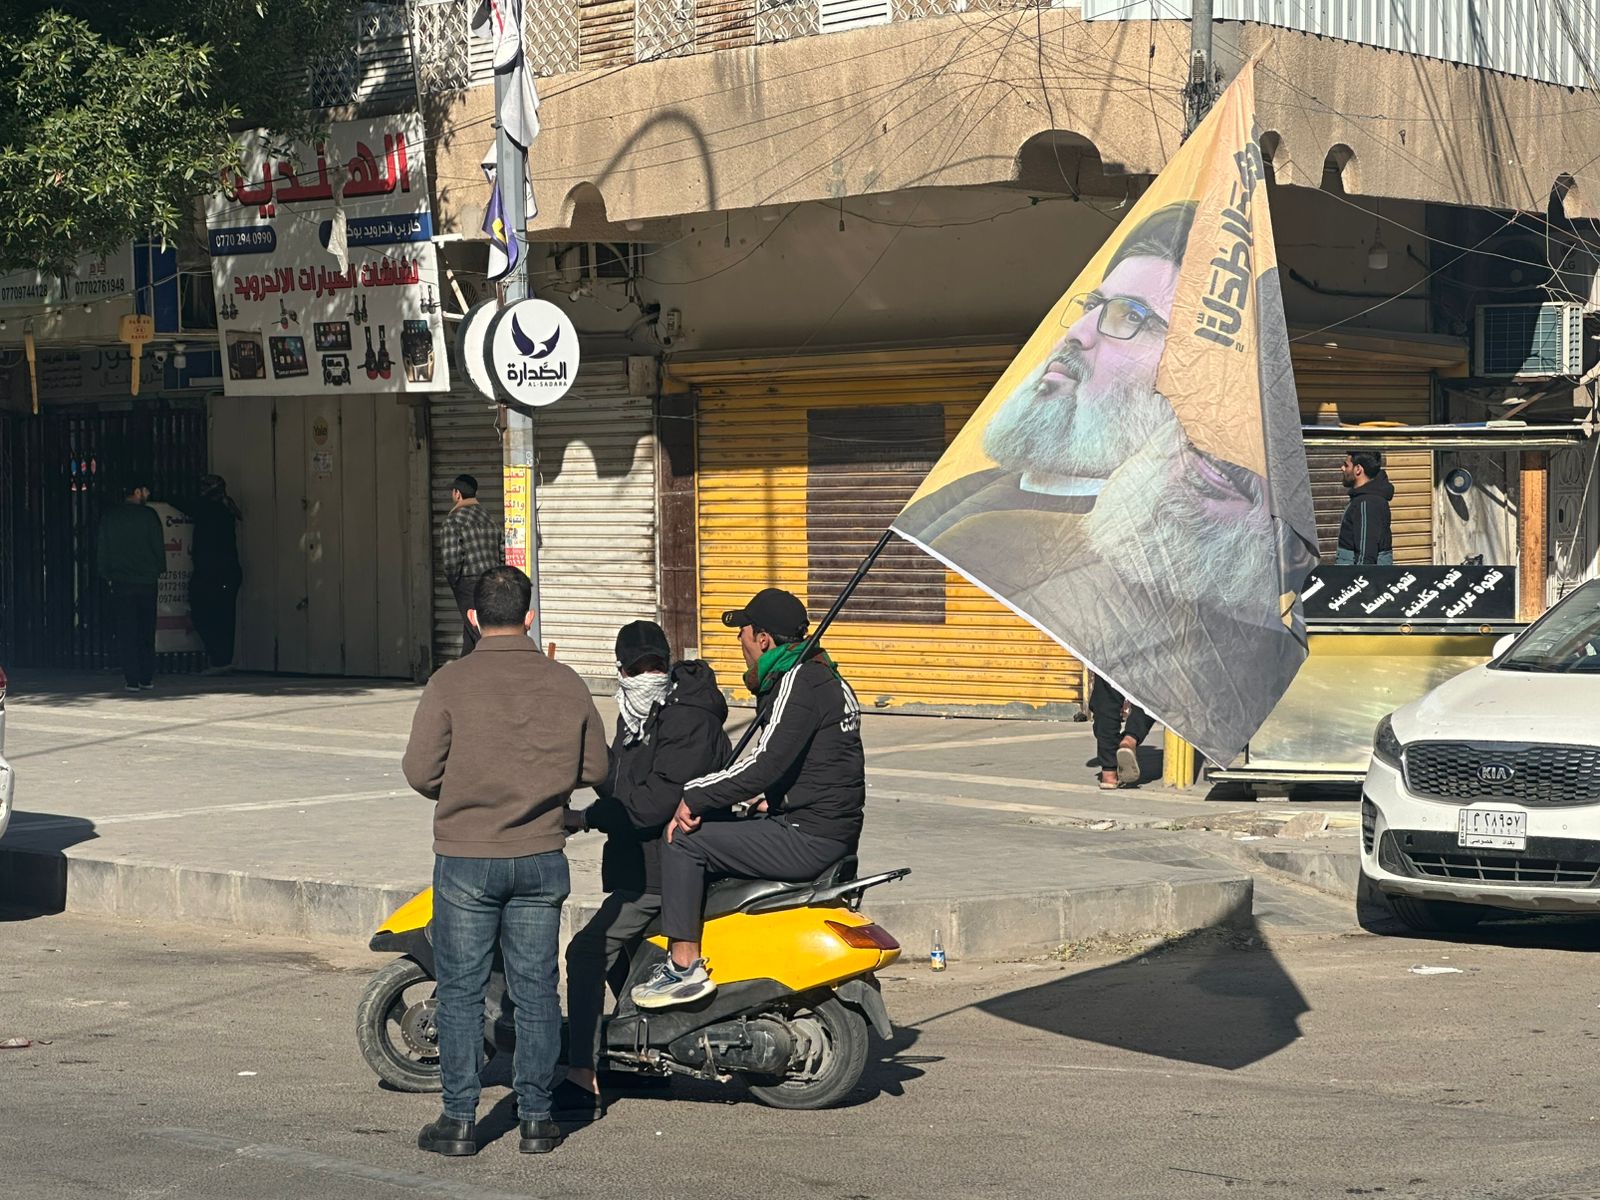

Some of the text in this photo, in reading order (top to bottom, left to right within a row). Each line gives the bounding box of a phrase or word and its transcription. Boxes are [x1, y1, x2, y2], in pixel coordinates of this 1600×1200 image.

[215, 231, 272, 247] 0770 294 0990
[75, 278, 125, 295] 07702761948
[1433, 568, 1462, 590] قهوة
[1328, 575, 1369, 611] كابتشينو
[1361, 571, 1416, 614] قهوة وسط
[1440, 568, 1503, 618] قهوة عربية
[1482, 766, 1507, 779] KIA
